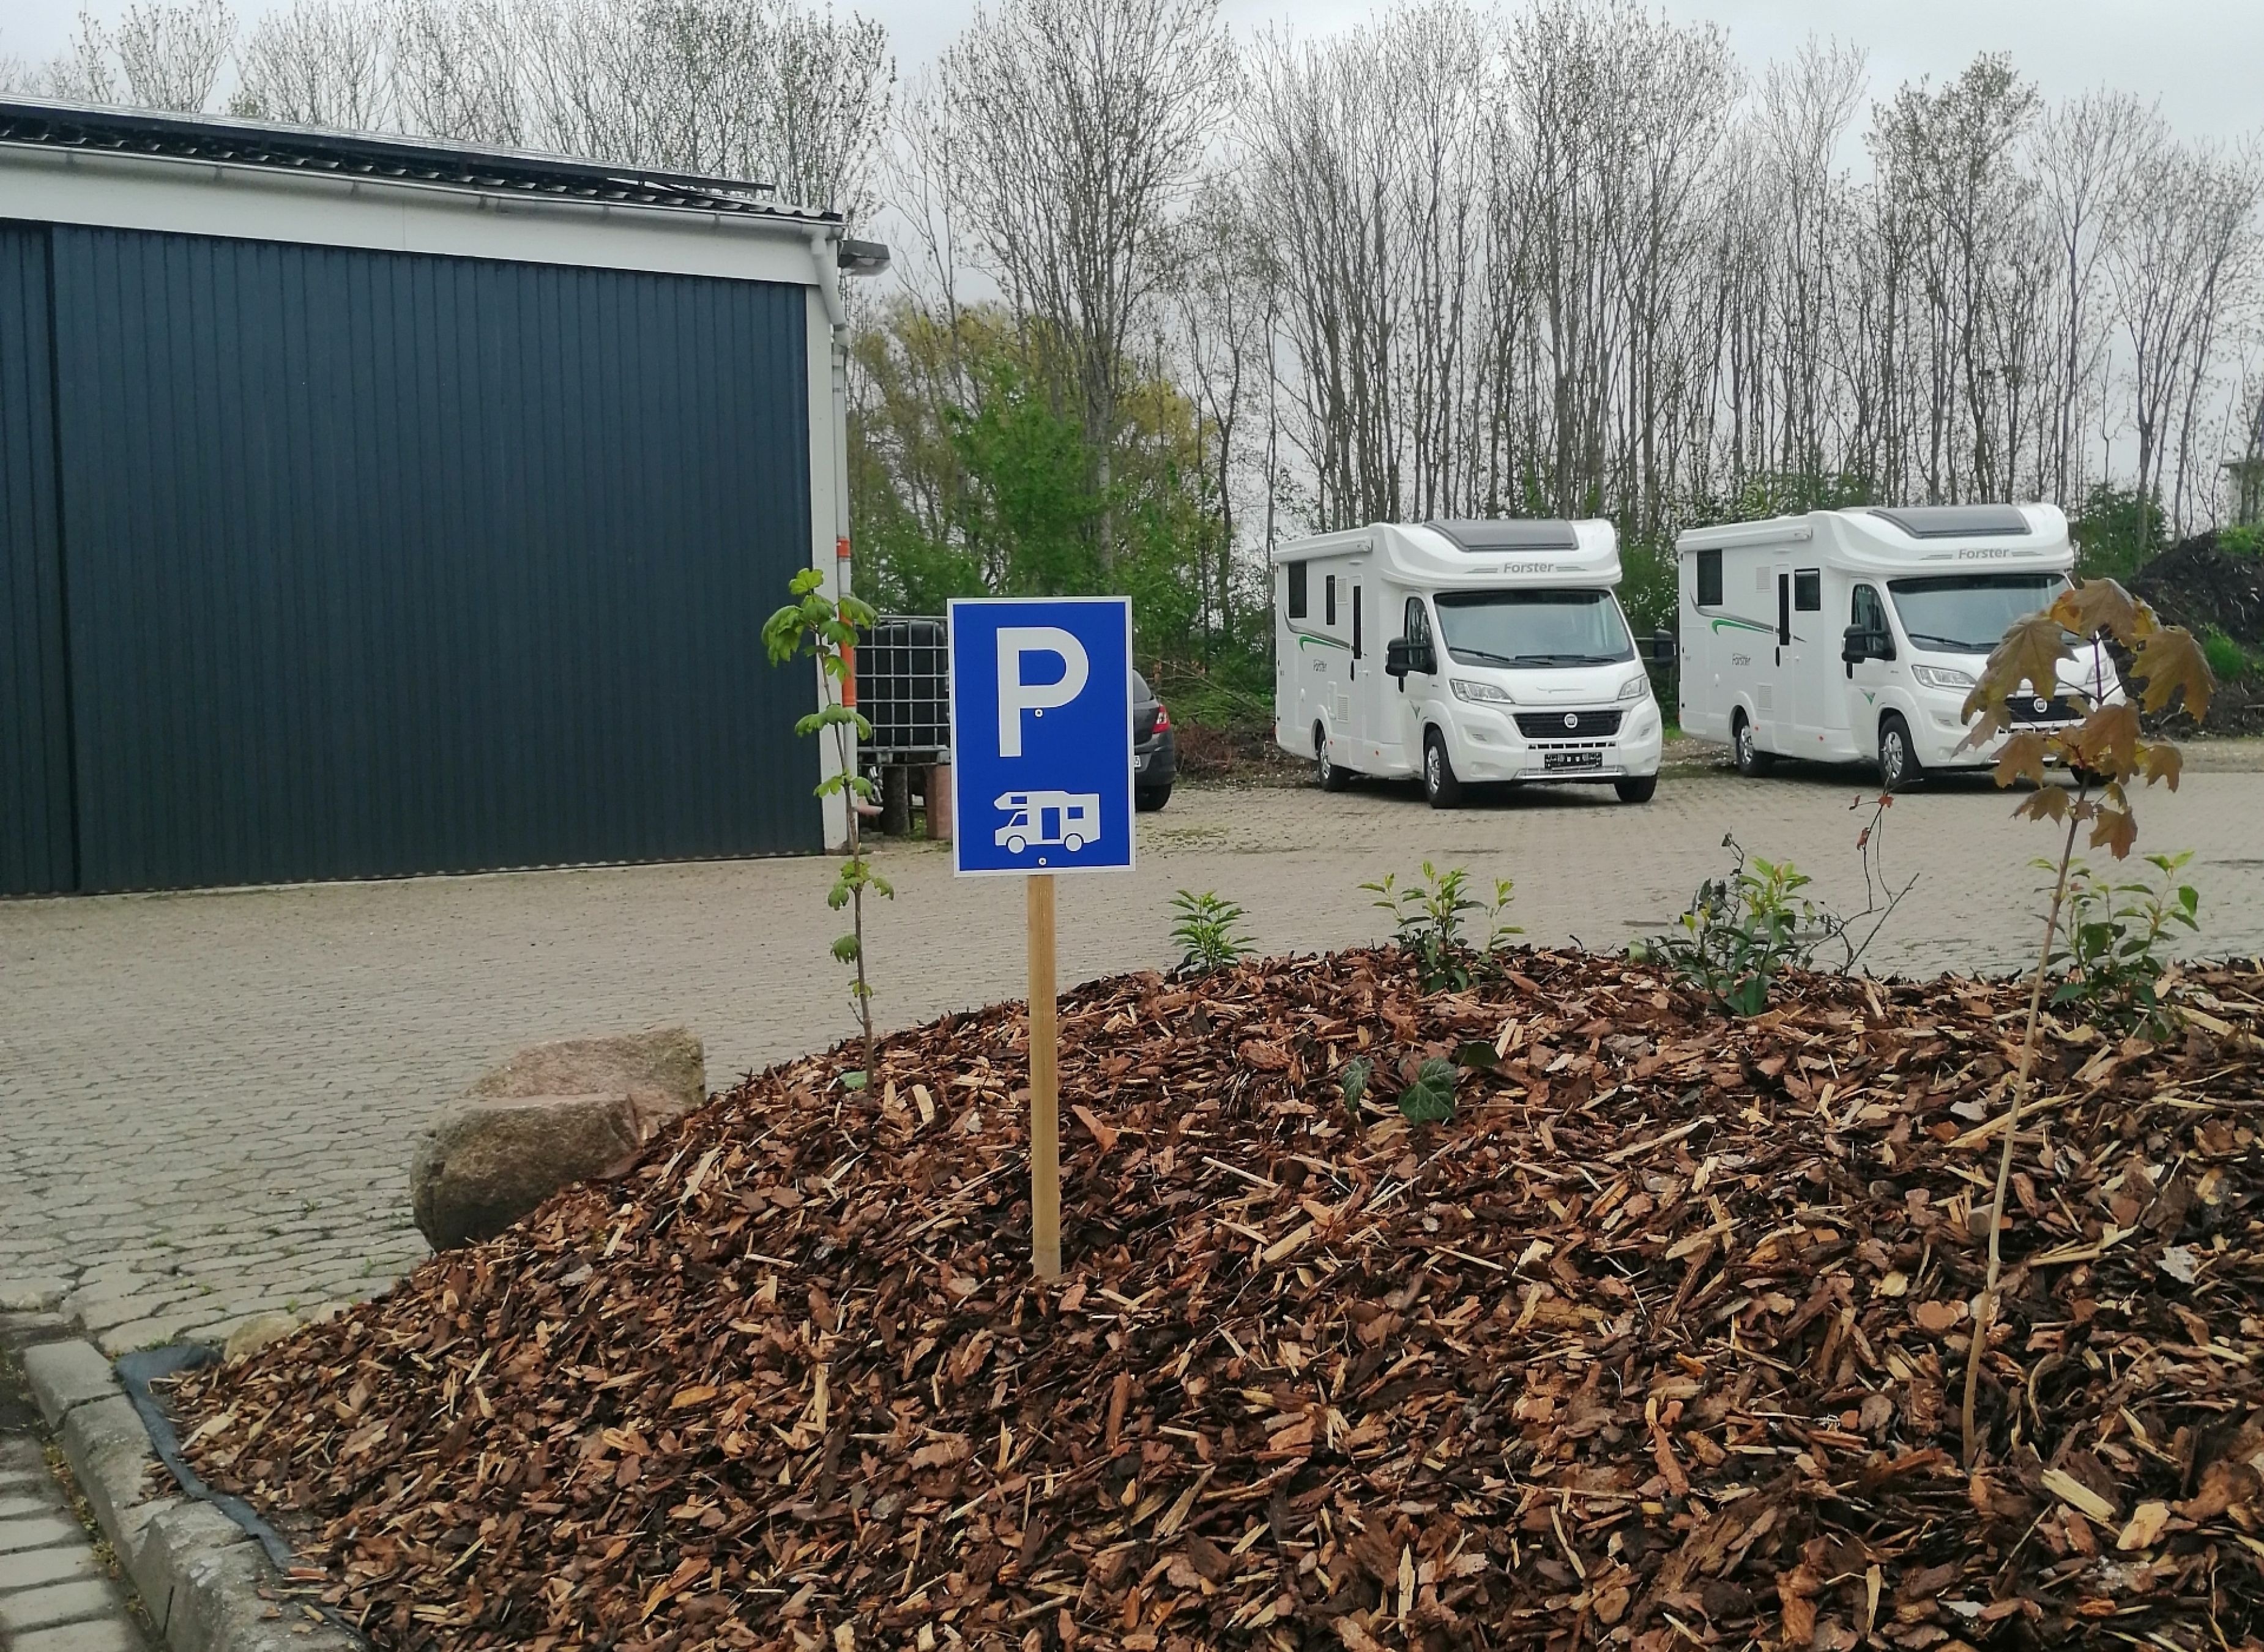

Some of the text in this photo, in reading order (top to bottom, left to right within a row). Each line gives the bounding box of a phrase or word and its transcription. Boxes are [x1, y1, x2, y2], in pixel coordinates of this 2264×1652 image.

[1958, 548, 2009, 559] Forster
[1503, 562, 1554, 573] Forster
[997, 627, 1089, 757] P
